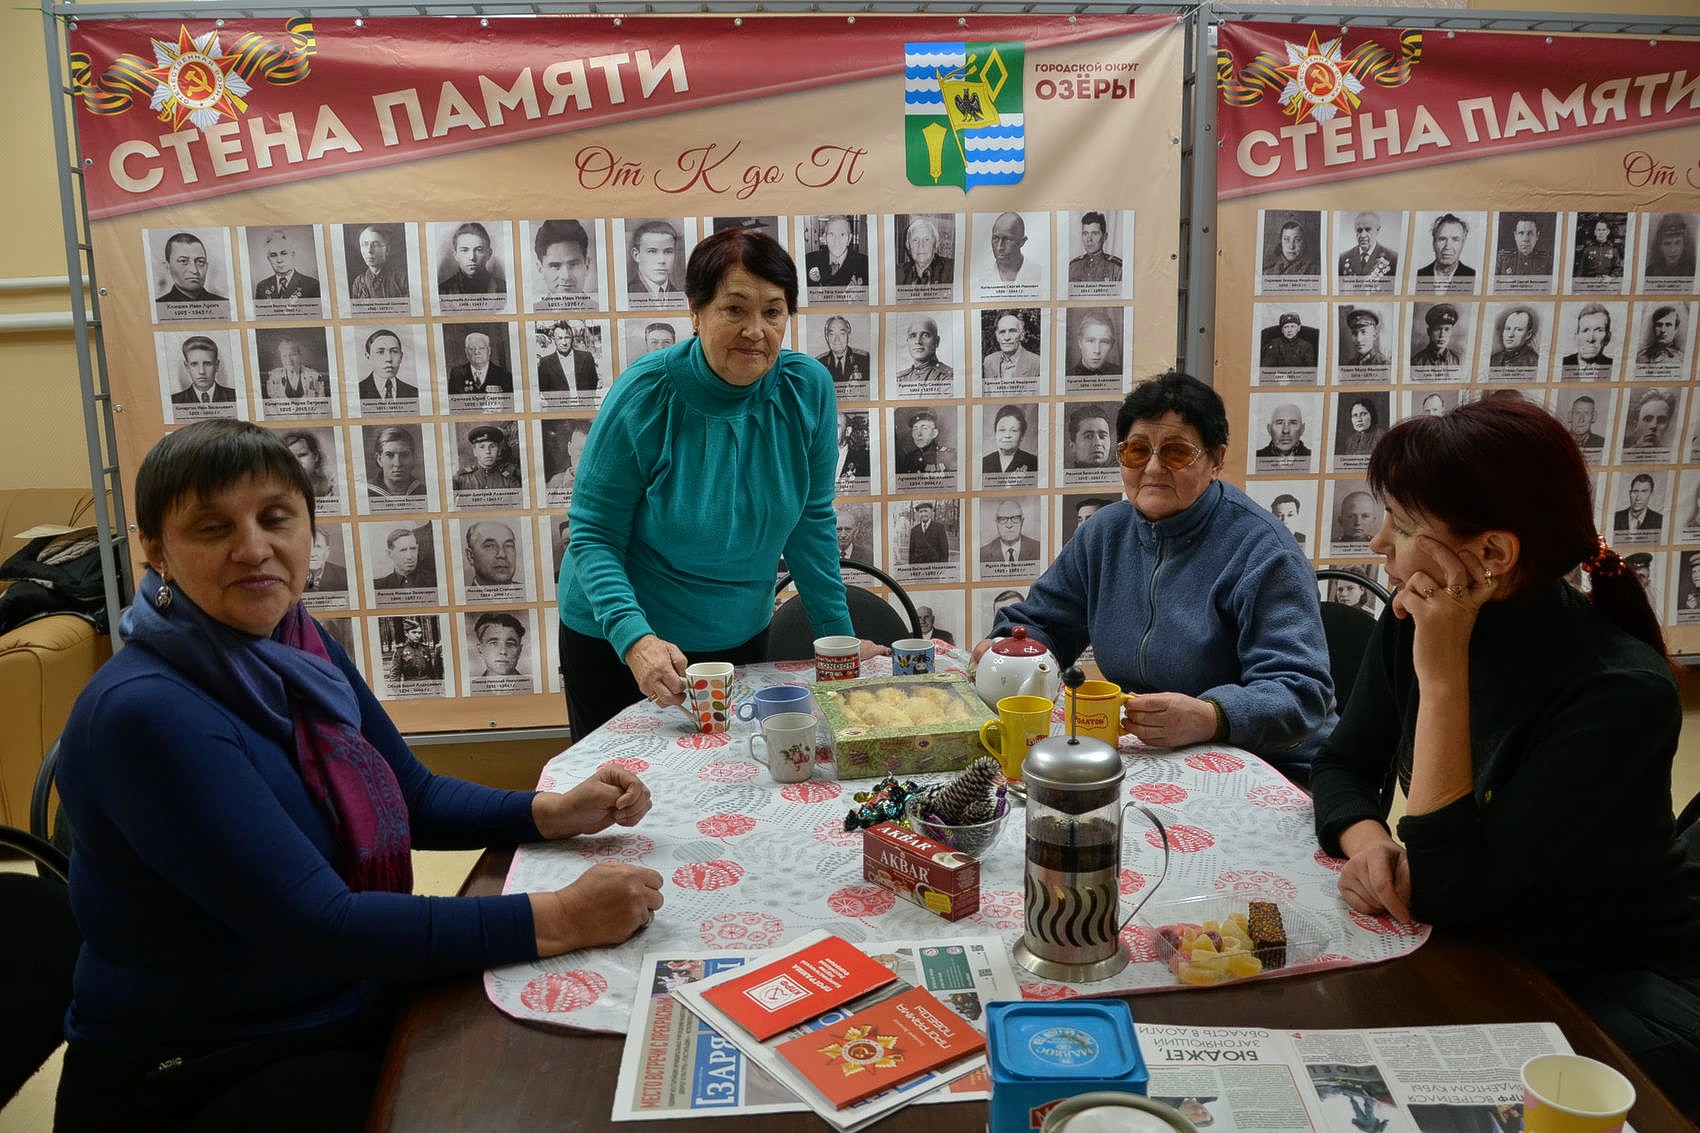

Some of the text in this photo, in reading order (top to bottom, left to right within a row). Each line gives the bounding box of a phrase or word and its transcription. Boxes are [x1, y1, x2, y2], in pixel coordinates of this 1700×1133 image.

[1035, 62, 1139, 72] ГОРОДСКОЙ ОКРУГ
[1035, 73, 1136, 100] ОЗЁРЫ
[109, 45, 688, 193] СТЕНА ПАМЯТИ
[1236, 70, 1700, 178] СТЕНА ПАМЯТИ
[574, 140, 869, 200] От К до П
[1623, 151, 1678, 187] От
[818, 661, 854, 670] LONDON
[877, 826, 936, 852] AKBAR
[880, 849, 930, 884] AKBAR
[896, 1004, 951, 1049] ПРОГРАММА
[914, 1005, 955, 1037] ПОБЕДЫ
[1191, 1030, 1199, 1038] В
[1203, 1029, 1270, 1039] ОБЛАСТЬ
[1153, 1038, 1261, 1049] ЗАГОНЯЮЩИЙ
[1158, 1047, 1258, 1062] БЮДЖЕТ,
